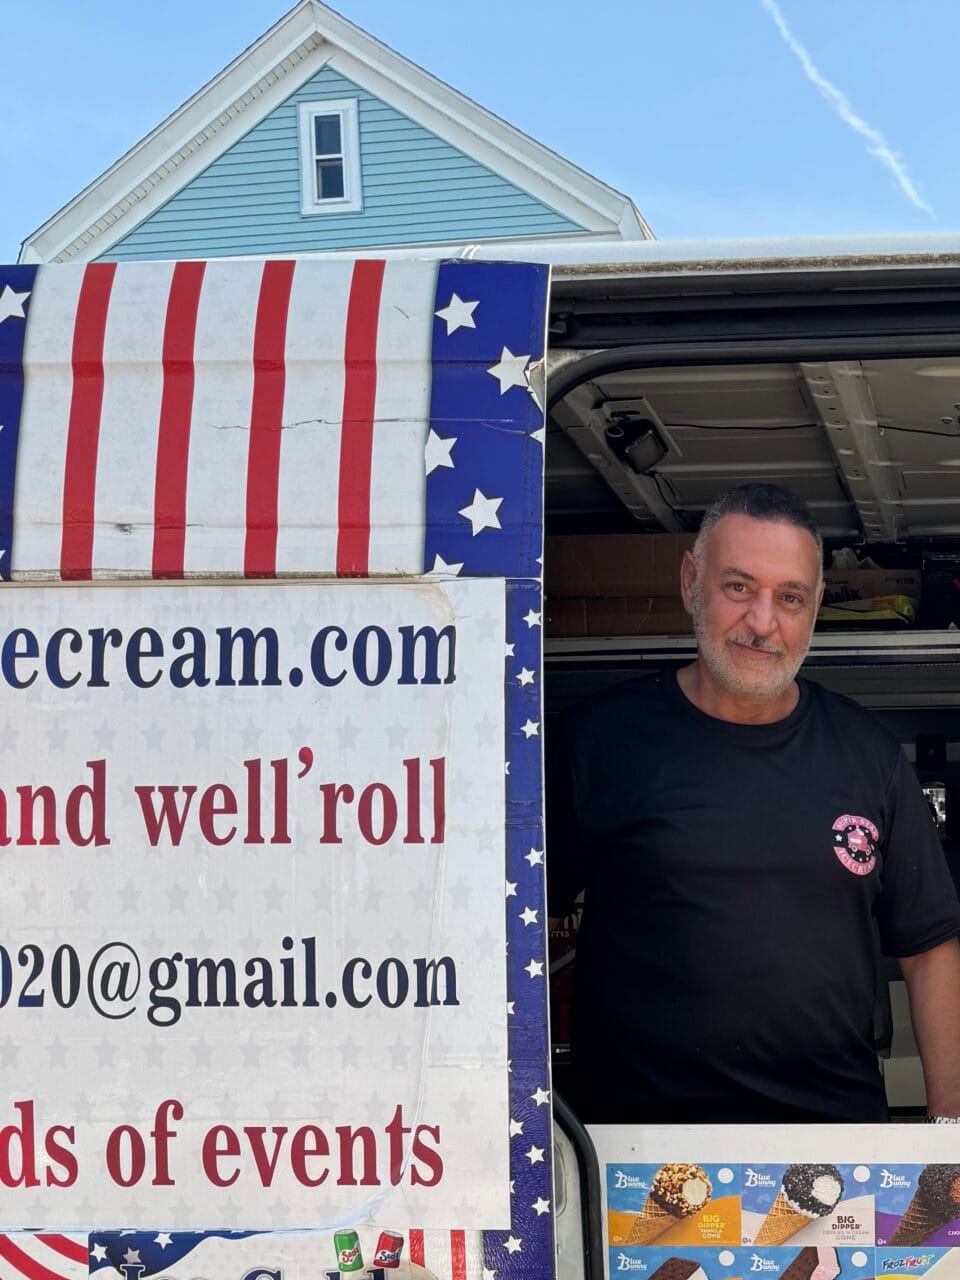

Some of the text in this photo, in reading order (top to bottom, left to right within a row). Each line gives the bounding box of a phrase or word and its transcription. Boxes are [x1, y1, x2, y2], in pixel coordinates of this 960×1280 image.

[1, 623, 456, 688] ecream.com
[106, 1099, 183, 1187] of
[201, 1103, 444, 1187] events
[703, 1215, 720, 1223] BIG
